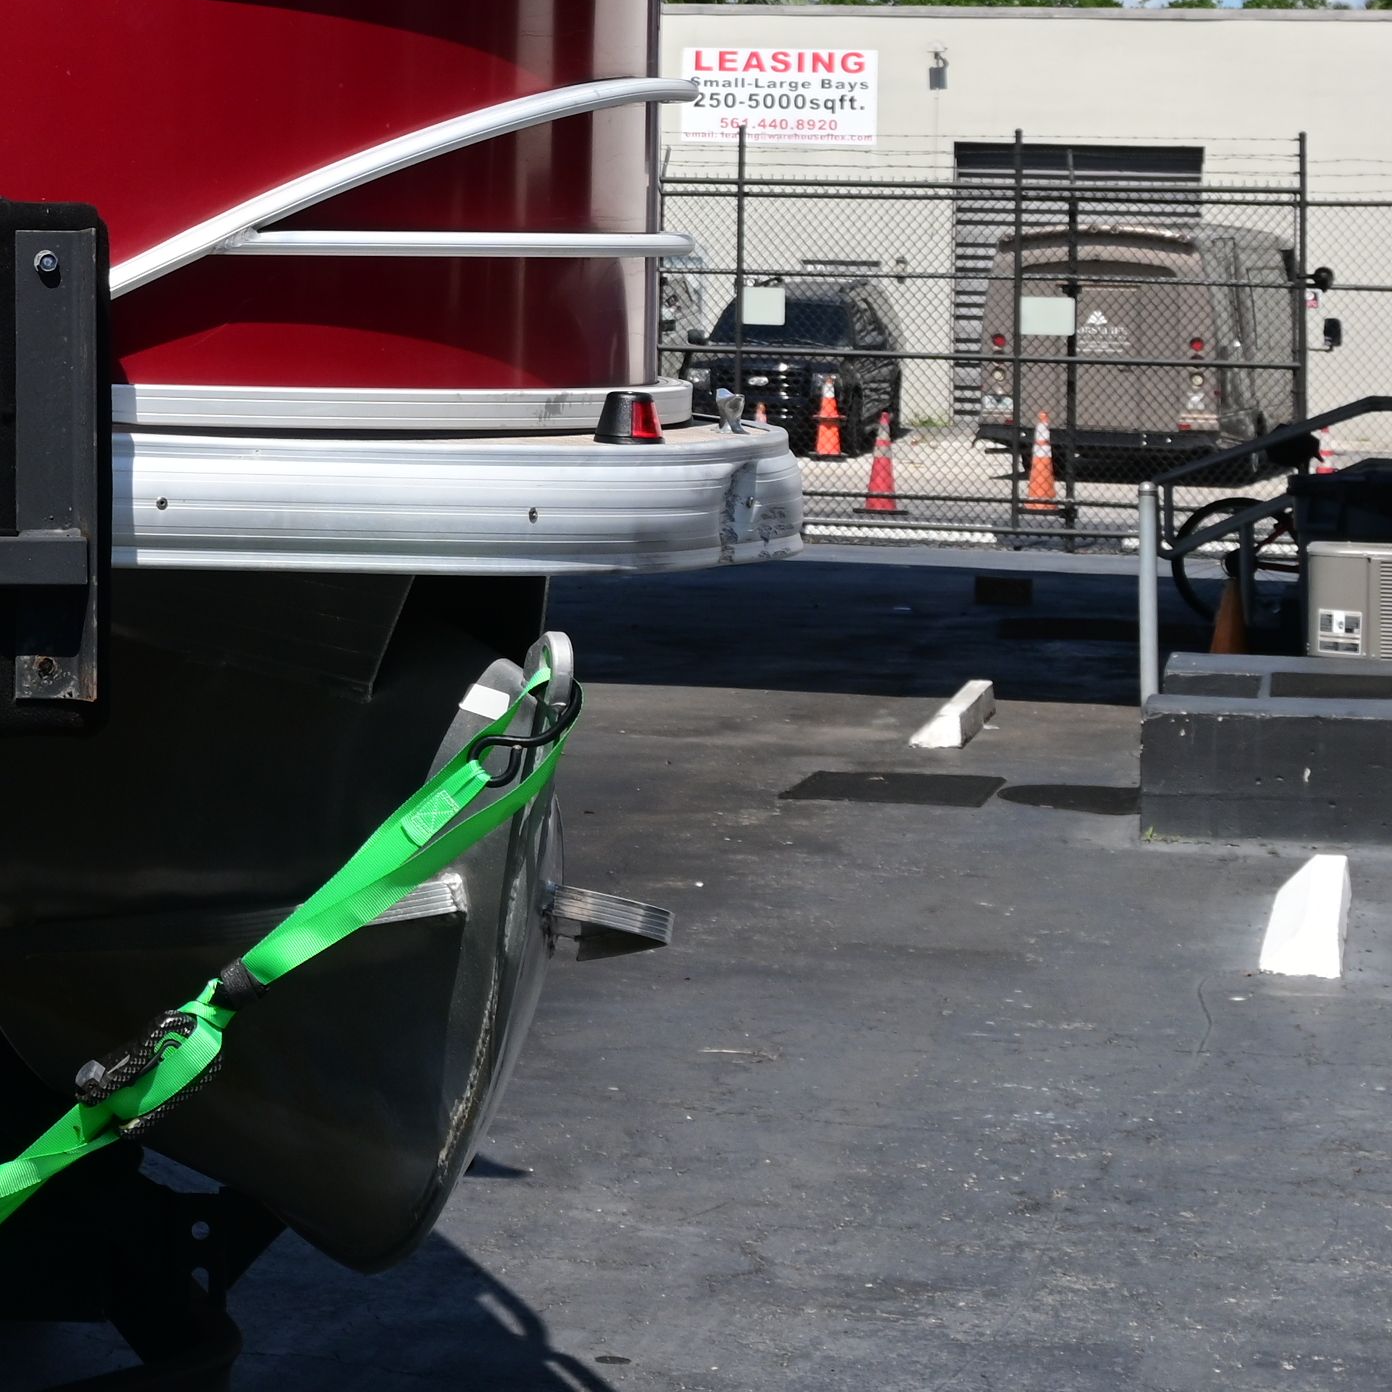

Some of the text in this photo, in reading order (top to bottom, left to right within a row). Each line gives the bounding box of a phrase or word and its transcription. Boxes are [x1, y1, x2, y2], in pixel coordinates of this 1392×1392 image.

[694, 50, 866, 74] LEASING
[691, 76, 870, 93] Small-Large Bays
[693, 92, 865, 114] 250-5000sqft.
